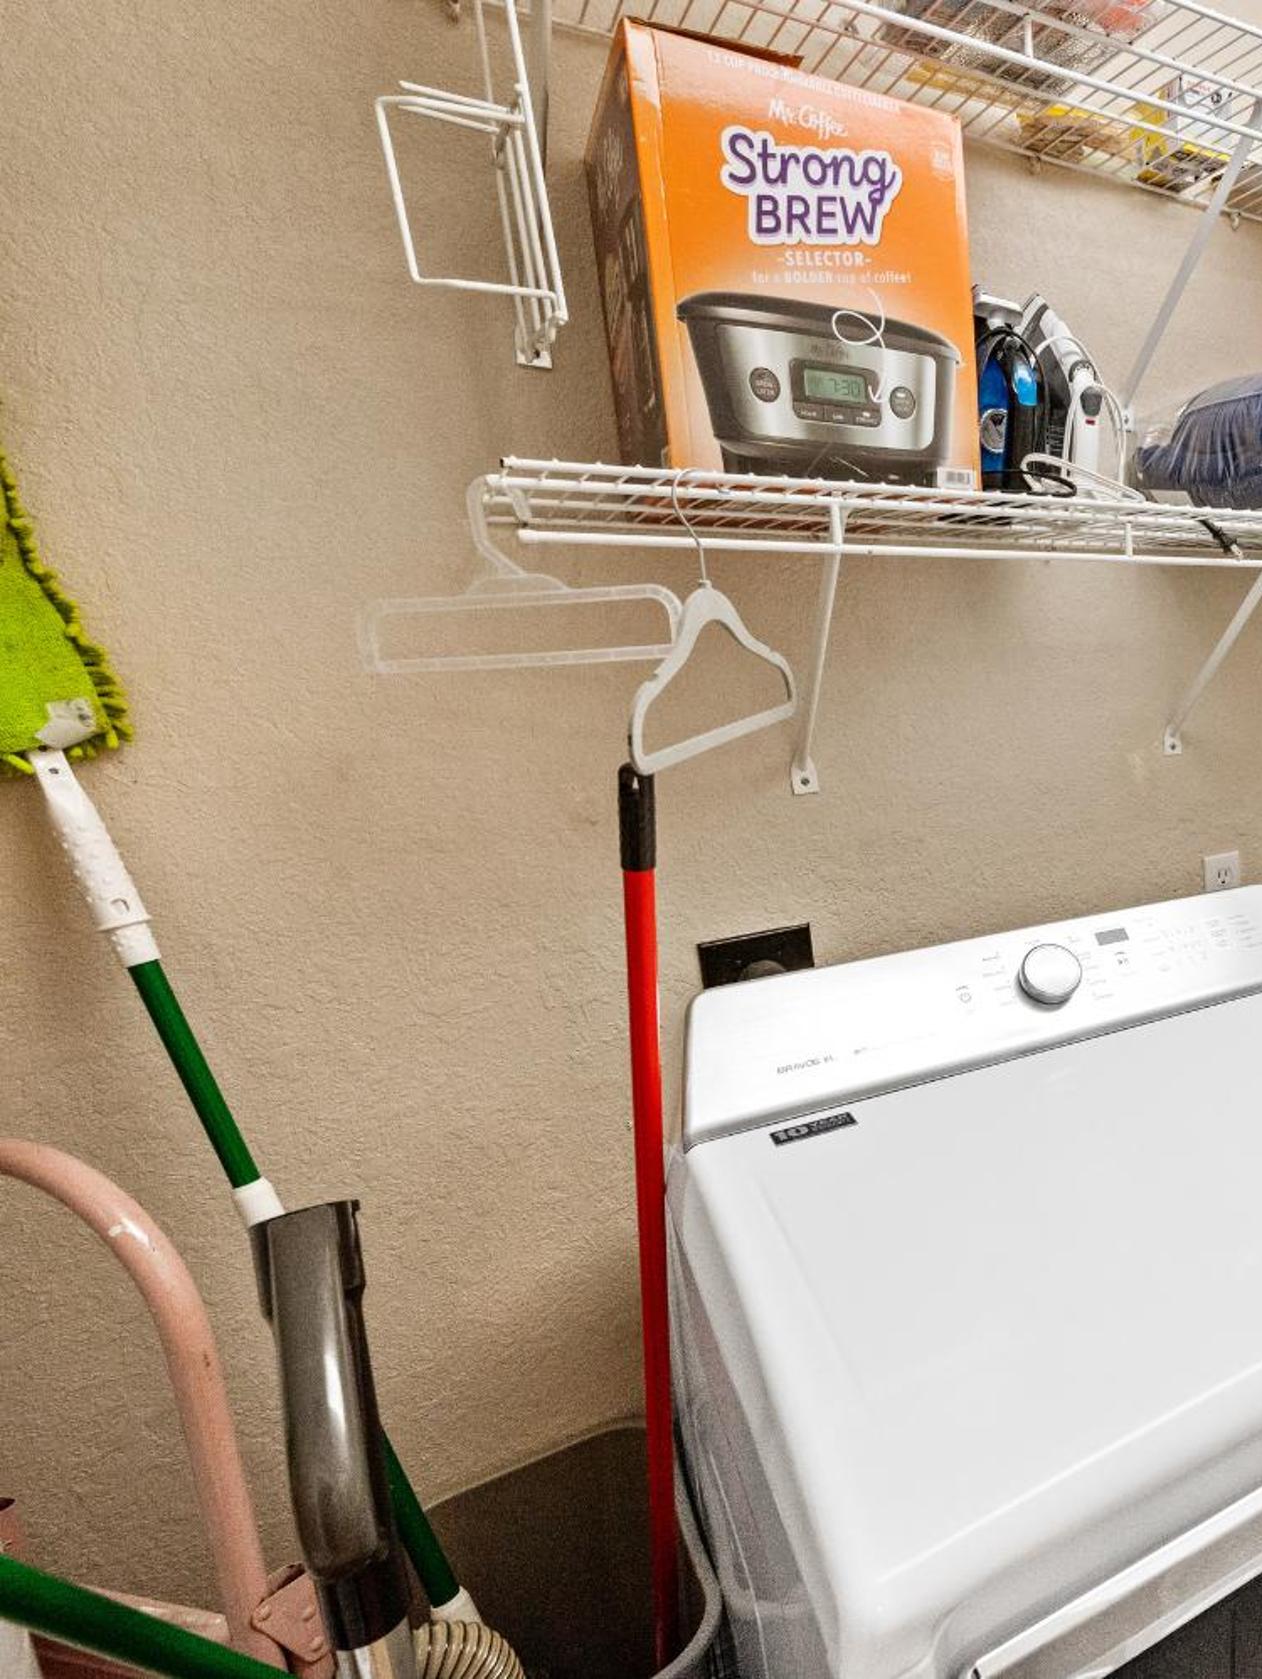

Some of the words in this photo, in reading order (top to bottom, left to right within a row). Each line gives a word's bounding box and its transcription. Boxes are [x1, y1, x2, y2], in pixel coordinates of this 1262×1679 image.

[798, 105, 849, 140] Coffee
[728, 132, 897, 206] Strong
[756, 194, 878, 235] BREW
[774, 1123, 810, 1143] 10
